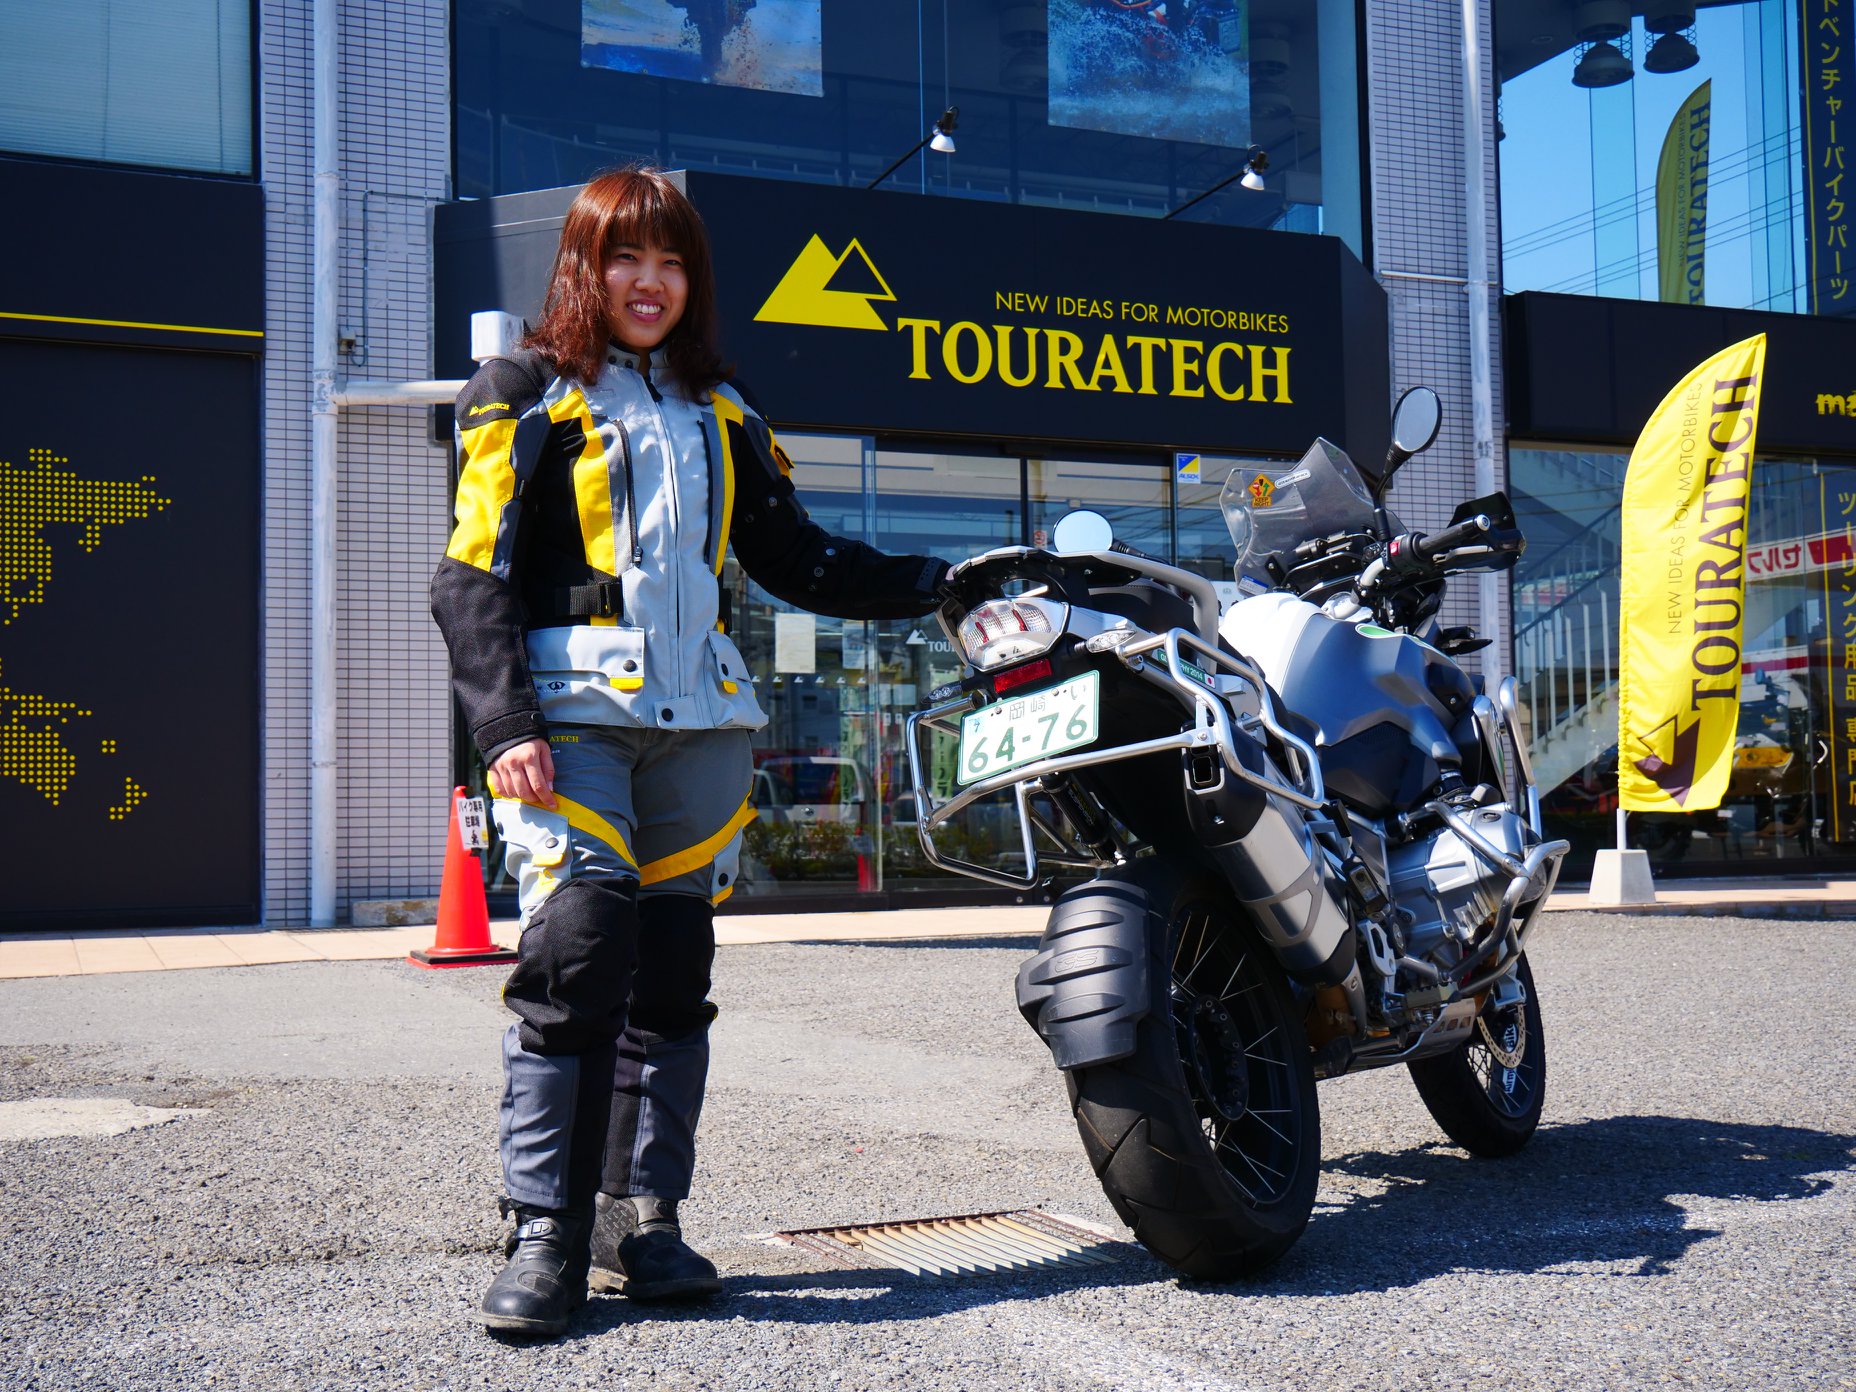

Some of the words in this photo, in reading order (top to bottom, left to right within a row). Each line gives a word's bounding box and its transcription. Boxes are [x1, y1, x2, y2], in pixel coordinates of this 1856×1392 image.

[1678, 183, 1686, 205] FOR
[1678, 206, 1686, 237] IDEAS
[995, 291, 1048, 313] NEW
[1057, 296, 1114, 319] IDEAS
[1121, 302, 1159, 323] FOR
[1166, 305, 1289, 333] MOTORBIKES
[897, 317, 1293, 404] TOURATECH
[1679, 382, 1703, 492] MOTORBIKES
[1673, 498, 1689, 530] FOR
[1669, 536, 1685, 585] IDEAS
[1691, 372, 1758, 711] TOURATECH
[1668, 591, 1682, 634] NEW
[1009, 695, 1046, 721] 岡崎
[968, 704, 1088, 773] 64-76
